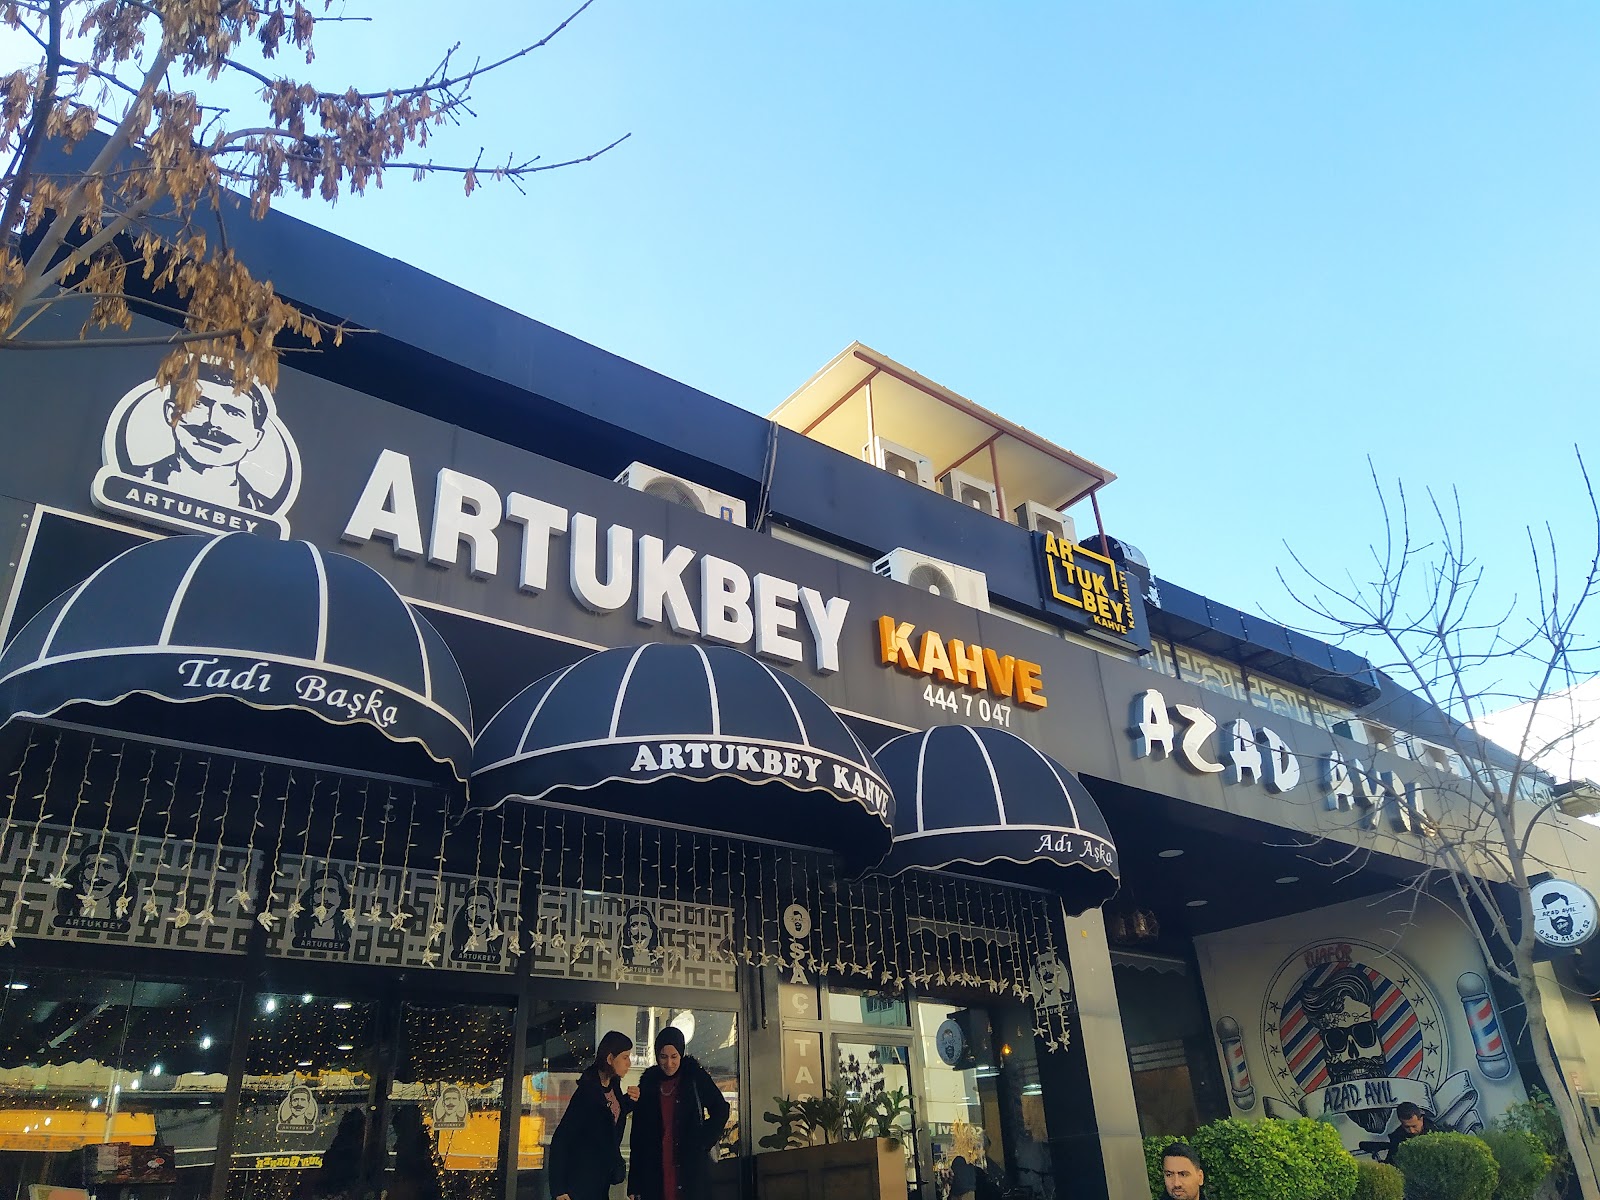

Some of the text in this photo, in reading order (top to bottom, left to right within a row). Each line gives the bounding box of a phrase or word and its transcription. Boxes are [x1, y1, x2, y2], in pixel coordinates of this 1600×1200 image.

[125, 488, 258, 532] ARTUKBEY
[341, 448, 850, 674] ARTUKBEY
[1046, 530, 1074, 563] AR
[1062, 560, 1109, 597] TUK
[1082, 589, 1123, 623] BEY
[1093, 615, 1127, 634] KAHVE
[879, 615, 1048, 710] KAHVE
[178, 657, 398, 728] Tadı Başka
[923, 685, 959, 713] 444
[1136, 689, 1300, 793] AZAD
[630, 743, 889, 818] ARTUKBEY KAHVE
[1034, 834, 1113, 866] Adı Aşka
[65, 918, 123, 930] ARTUKBEY
[1545, 933, 1559, 941] 543
[301, 939, 344, 949] ARTUKBEY
[458, 952, 496, 962] ARTUKBEY
[625, 965, 660, 974] RTUKBEY
[1038, 1005, 1070, 1017] ARUKEY
